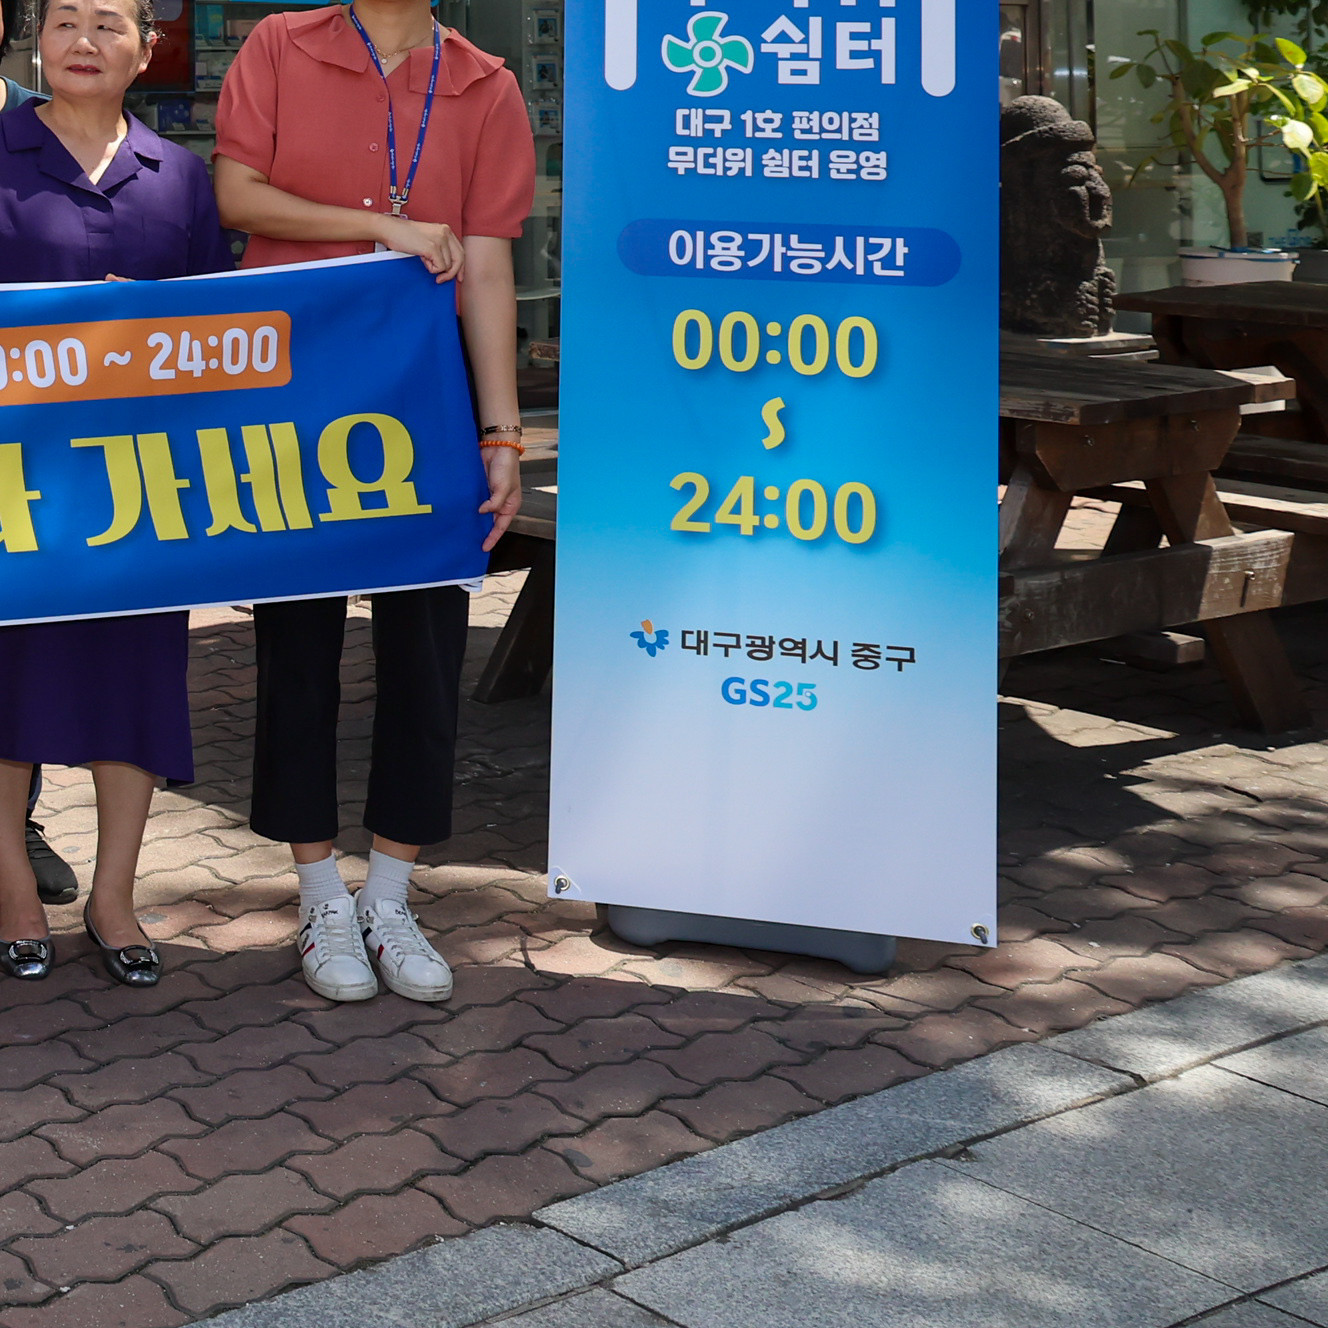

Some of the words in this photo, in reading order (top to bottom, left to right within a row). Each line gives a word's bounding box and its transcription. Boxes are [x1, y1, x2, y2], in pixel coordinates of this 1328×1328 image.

[760, 14, 896, 85] 쉼터
[675, 108, 732, 138] 대구
[740, 109, 784, 139] 1호
[791, 110, 880, 142] 편의점
[667, 146, 753, 176] 무더위
[761, 148, 820, 179] 쉼터
[828, 151, 888, 181] 운영
[668, 229, 909, 277] 이용가능시간
[148, 324, 281, 380] 24:00
[671, 308, 879, 379] 00:00
[69, 411, 434, 548] 가세요
[668, 471, 877, 544] 24:00
[681, 629, 840, 667] 대구광역시
[850, 641, 917, 672] 중구
[720, 676, 818, 711] GS25
